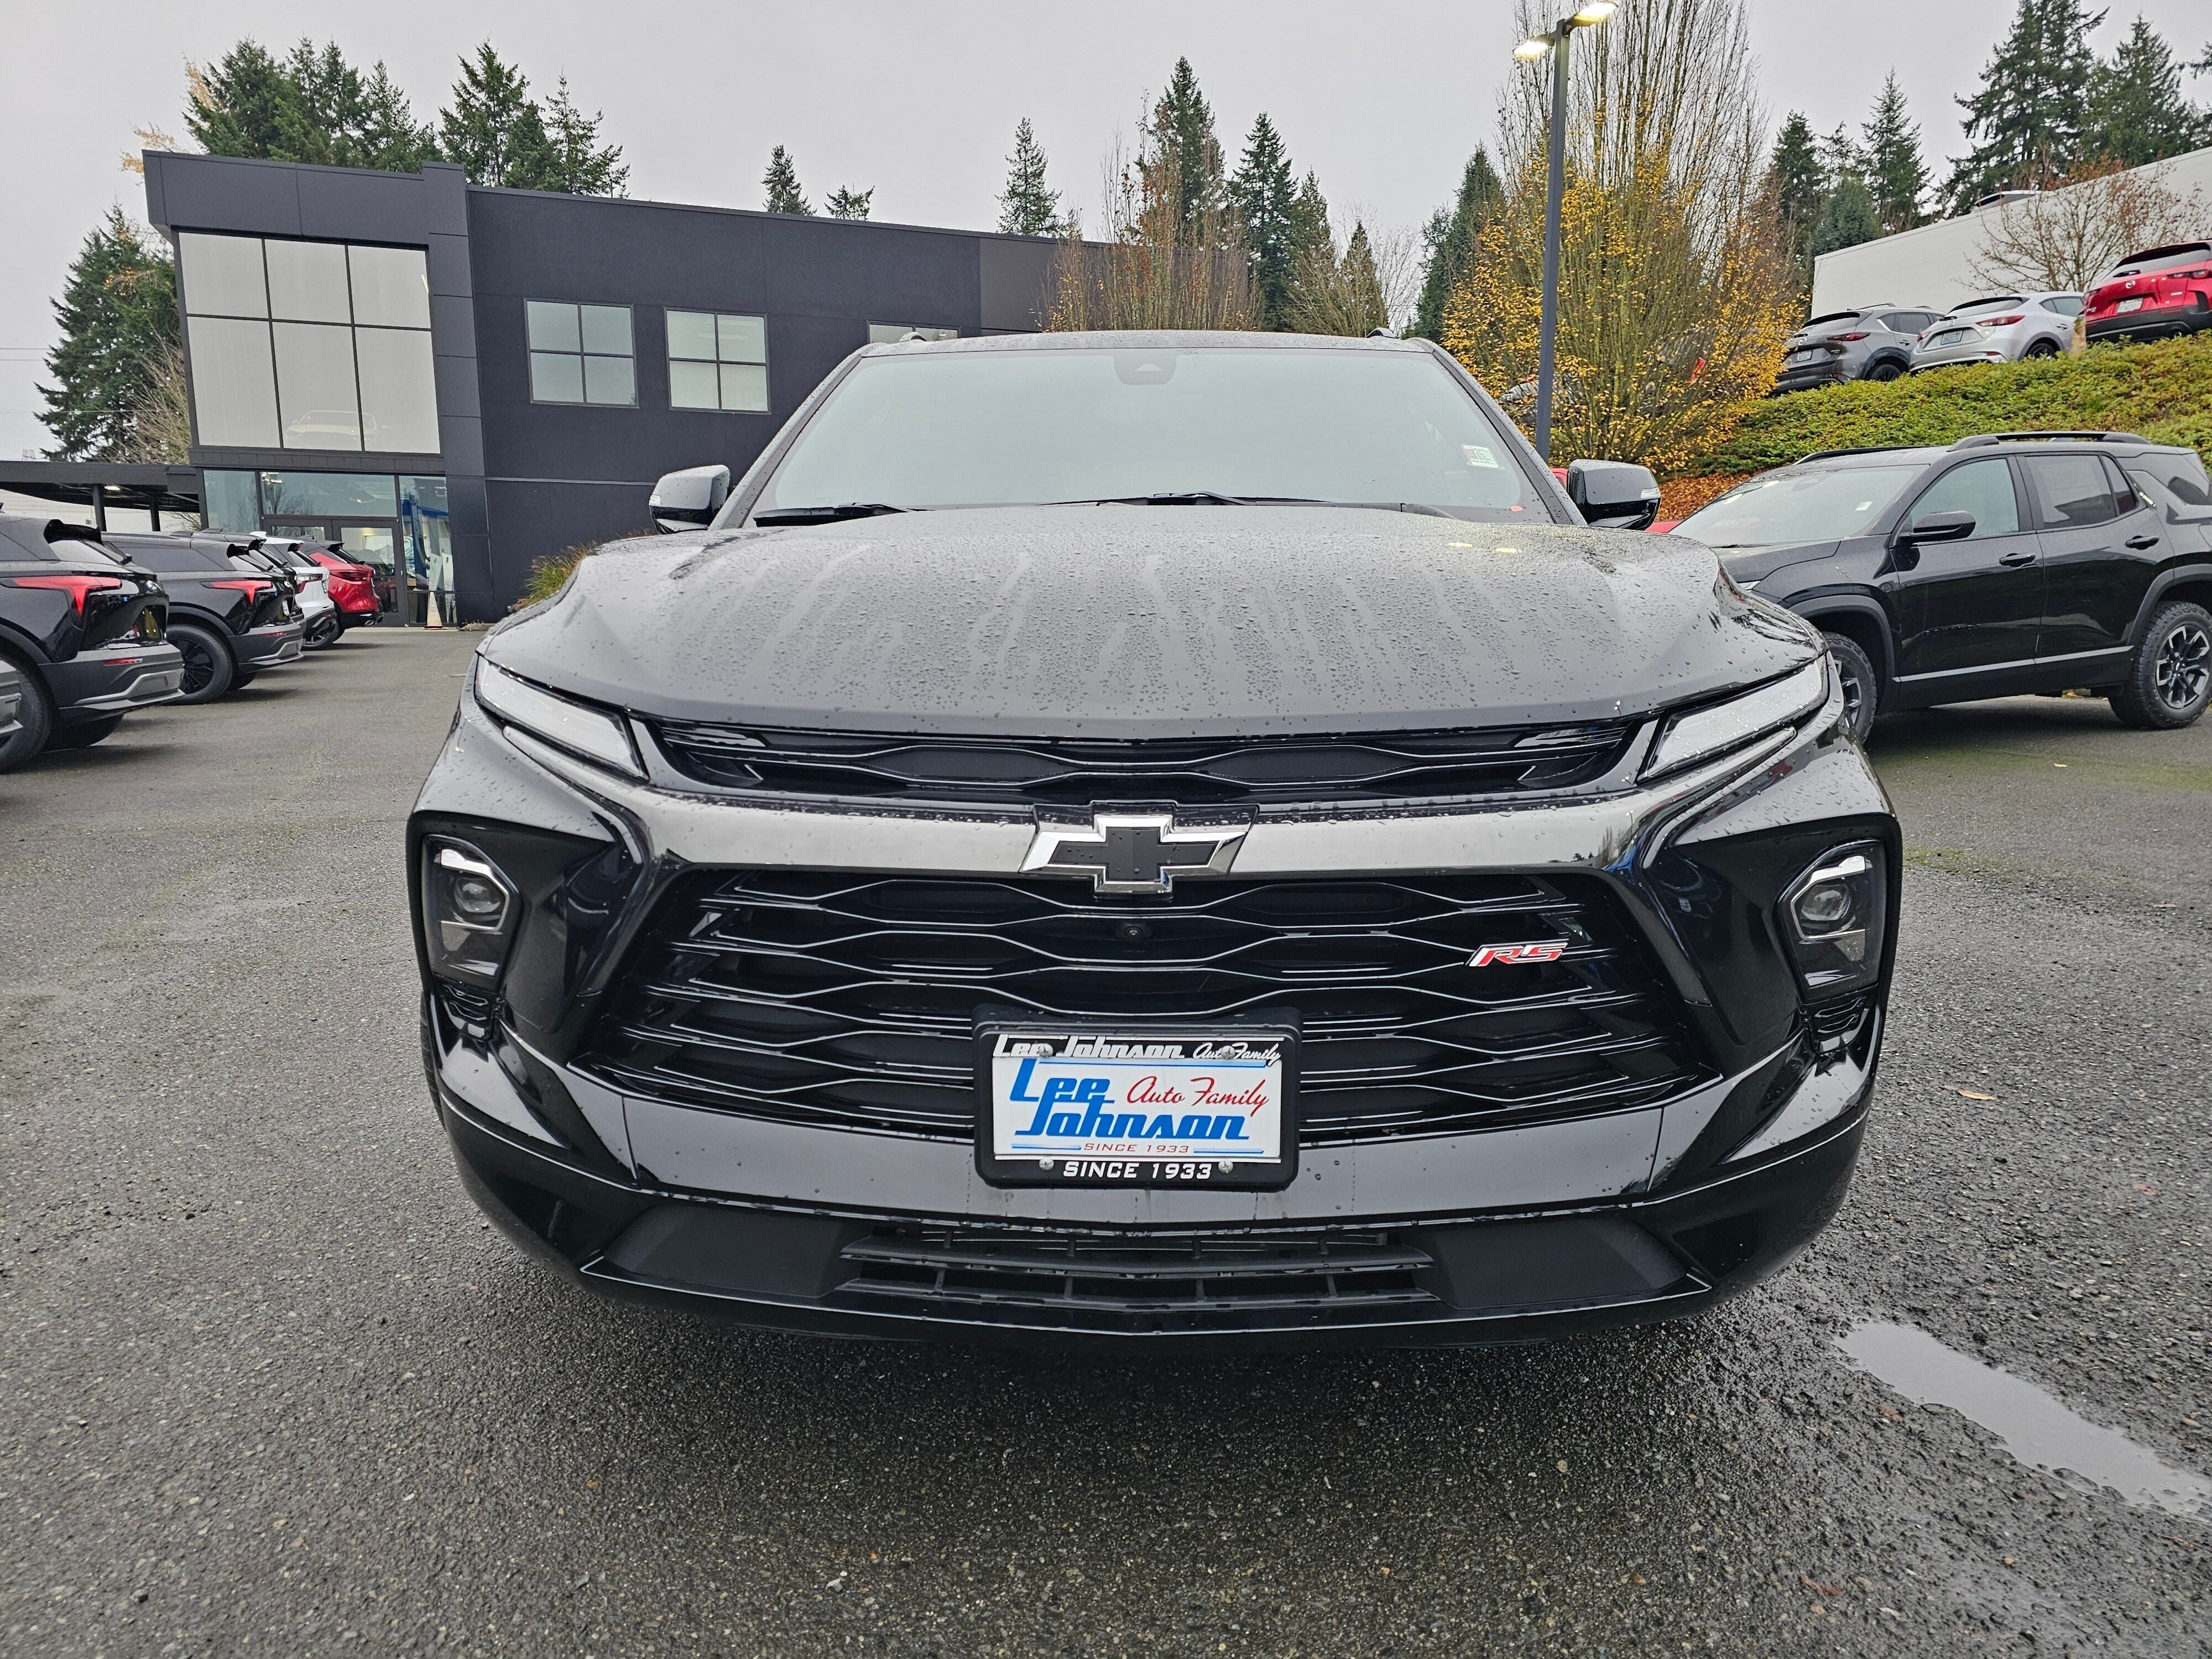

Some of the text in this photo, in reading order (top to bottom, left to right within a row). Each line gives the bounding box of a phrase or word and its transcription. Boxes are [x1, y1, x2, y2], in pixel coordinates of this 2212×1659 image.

[1469, 942, 1568, 967] RS
[1055, 1035, 1185, 1059] Johnson
[1192, 1042, 1235, 1060] Aut
[1232, 1042, 1281, 1067] Family
[1010, 1058, 1115, 1104] Lee
[1126, 1076, 1270, 1117] Auto Family
[1014, 1098, 1249, 1140] Johnson
[1084, 1142, 1190, 1154] SINCE 1933
[1063, 1161, 1212, 1180] SINCE 1933
